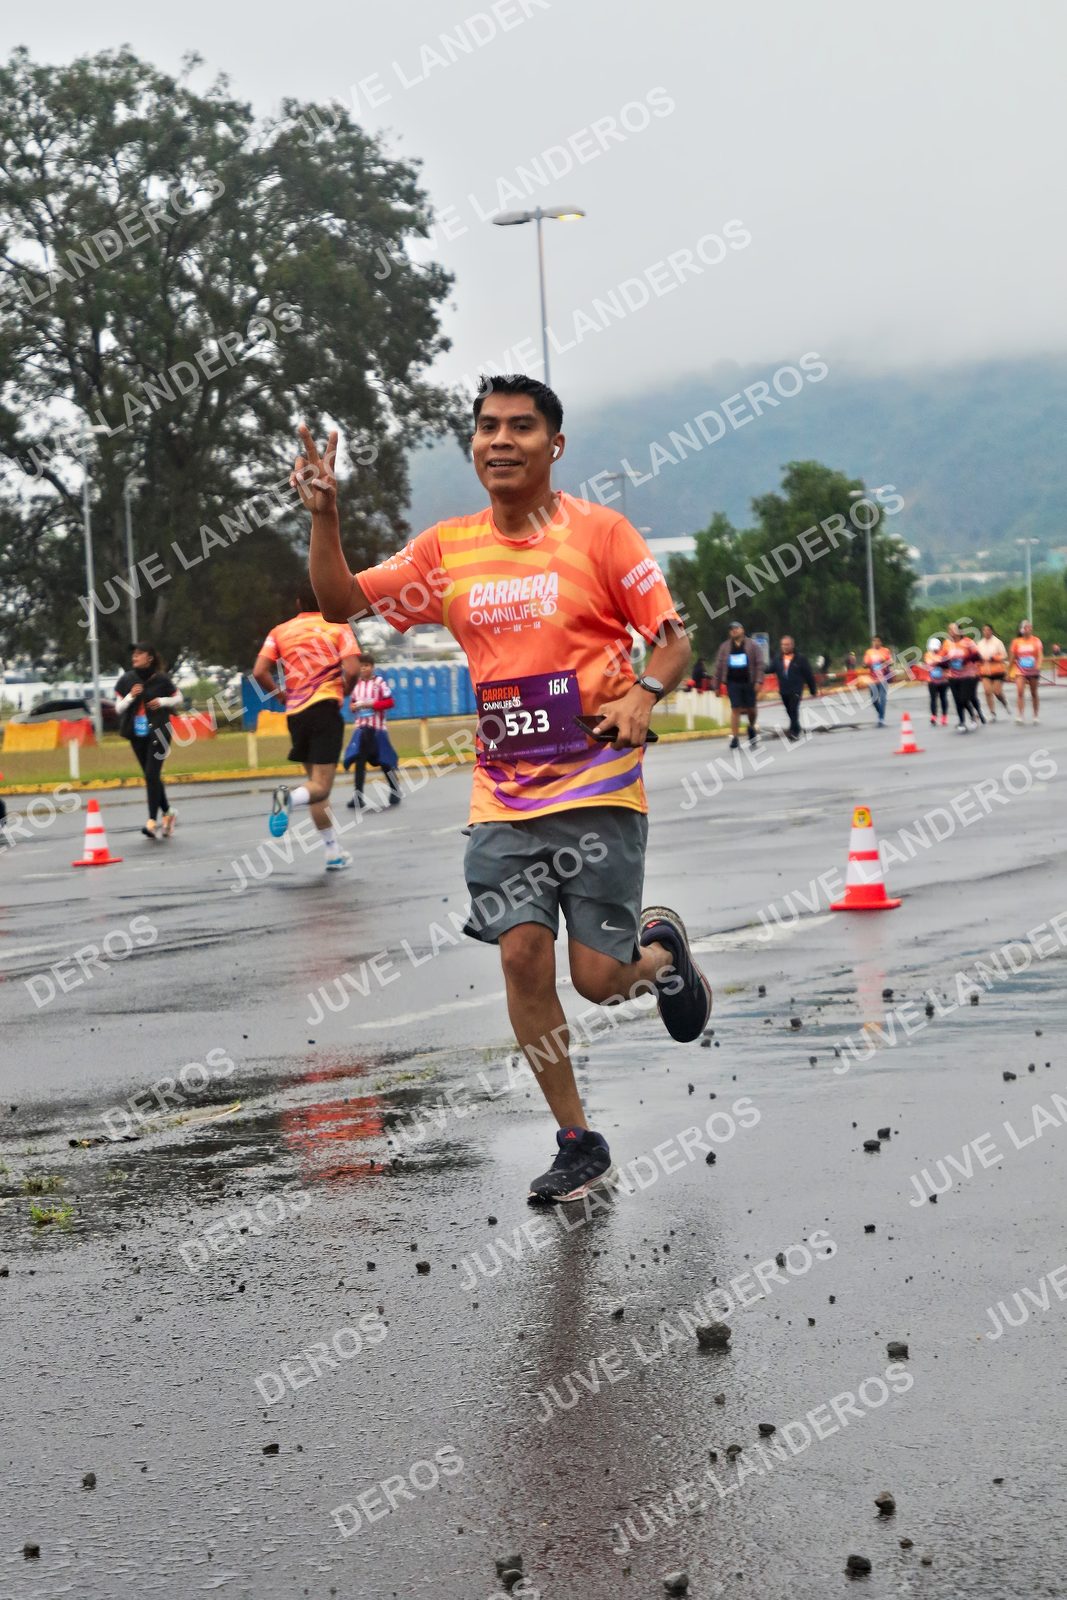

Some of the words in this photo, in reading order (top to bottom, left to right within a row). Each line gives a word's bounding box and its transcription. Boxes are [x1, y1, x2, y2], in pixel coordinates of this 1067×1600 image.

[469, 572, 558, 608] CARRERA
[482, 686, 520, 702] CARRERA
[504, 709, 550, 737] 523
